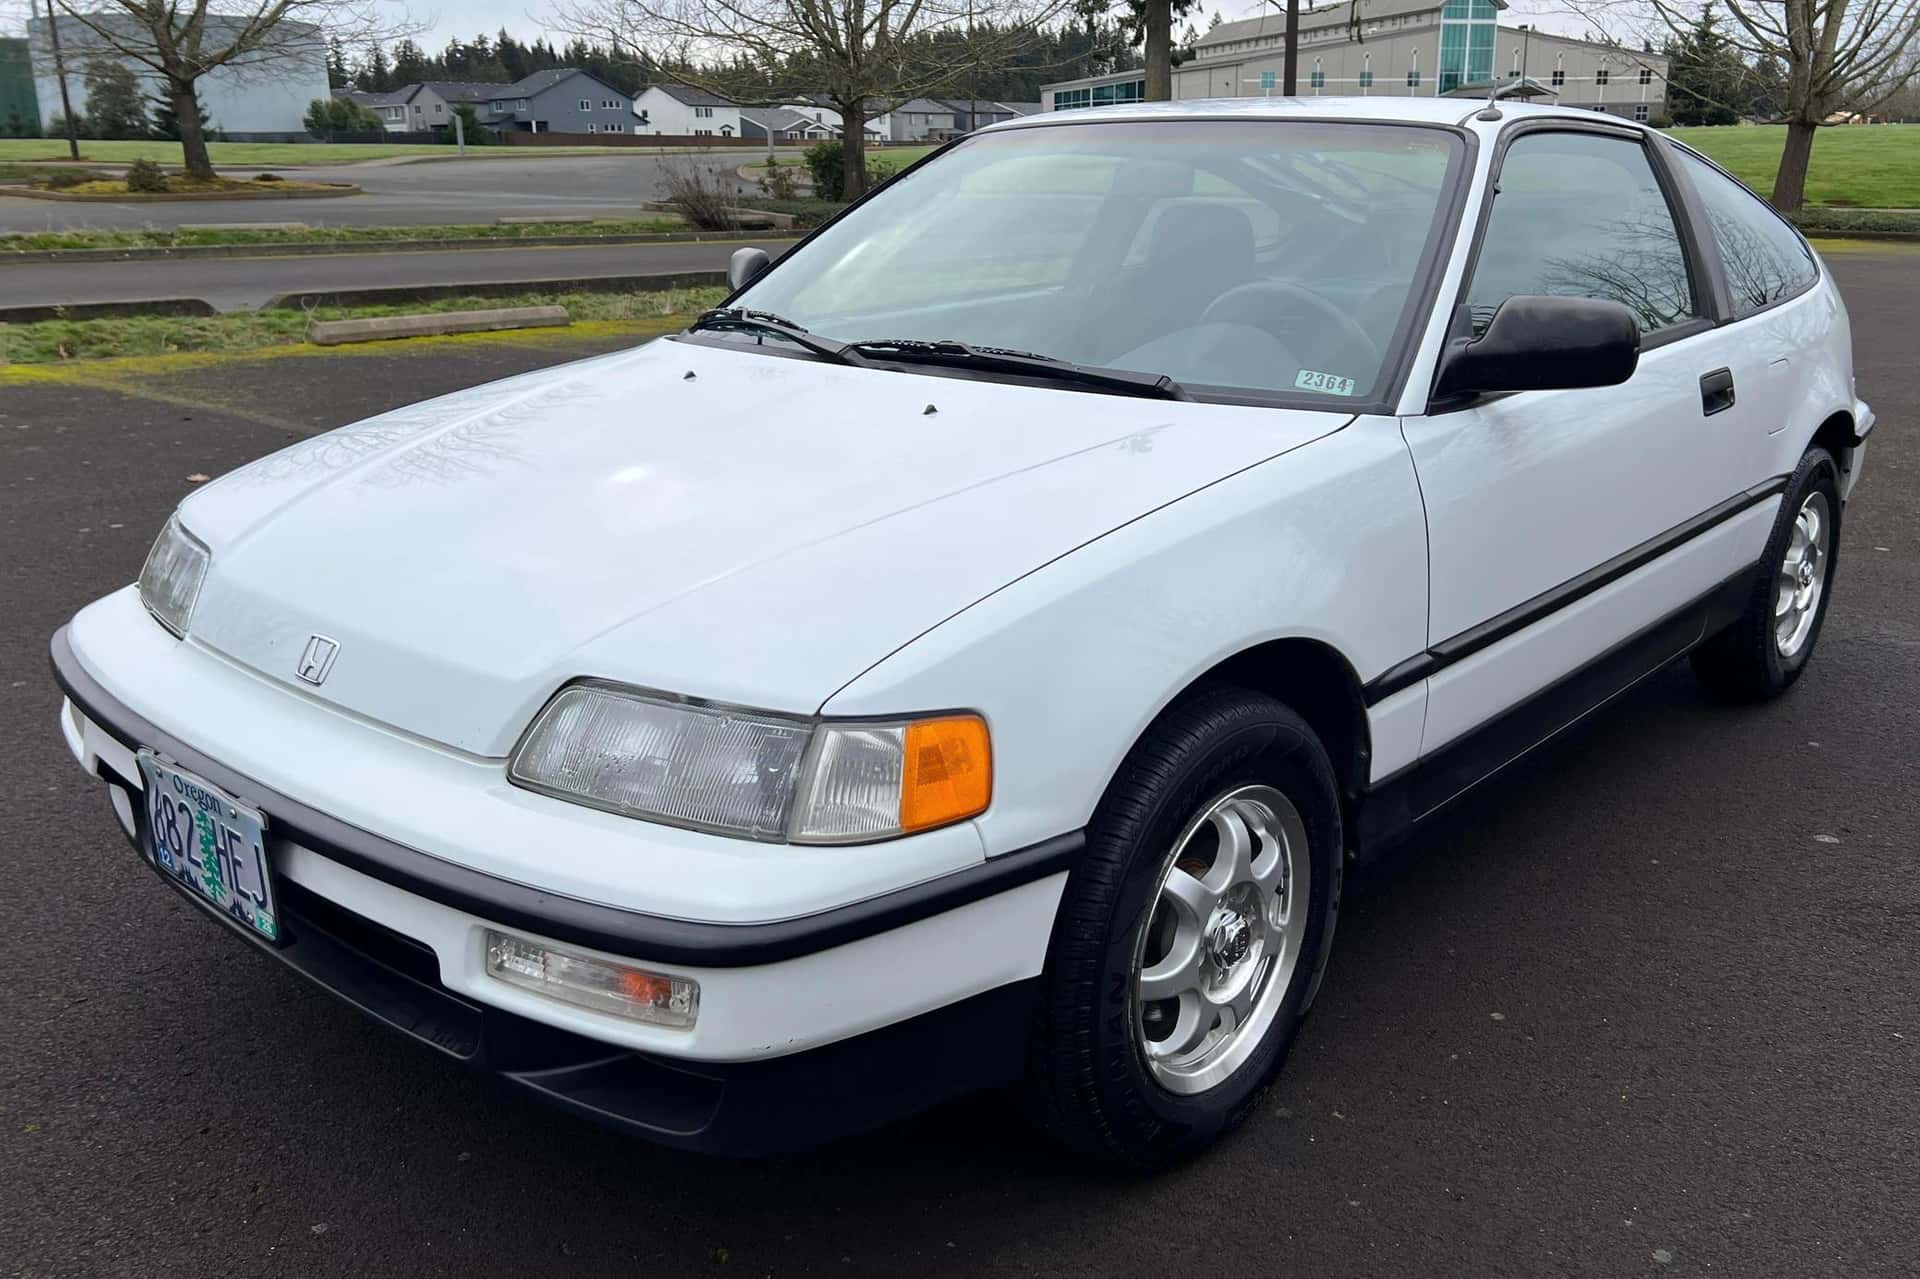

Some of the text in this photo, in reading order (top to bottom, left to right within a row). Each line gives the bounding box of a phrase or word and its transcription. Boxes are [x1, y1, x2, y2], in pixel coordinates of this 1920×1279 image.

[1302, 372, 1347, 392] 2364
[173, 774, 223, 816] Oregon
[154, 784, 268, 910] 682 HEJ
